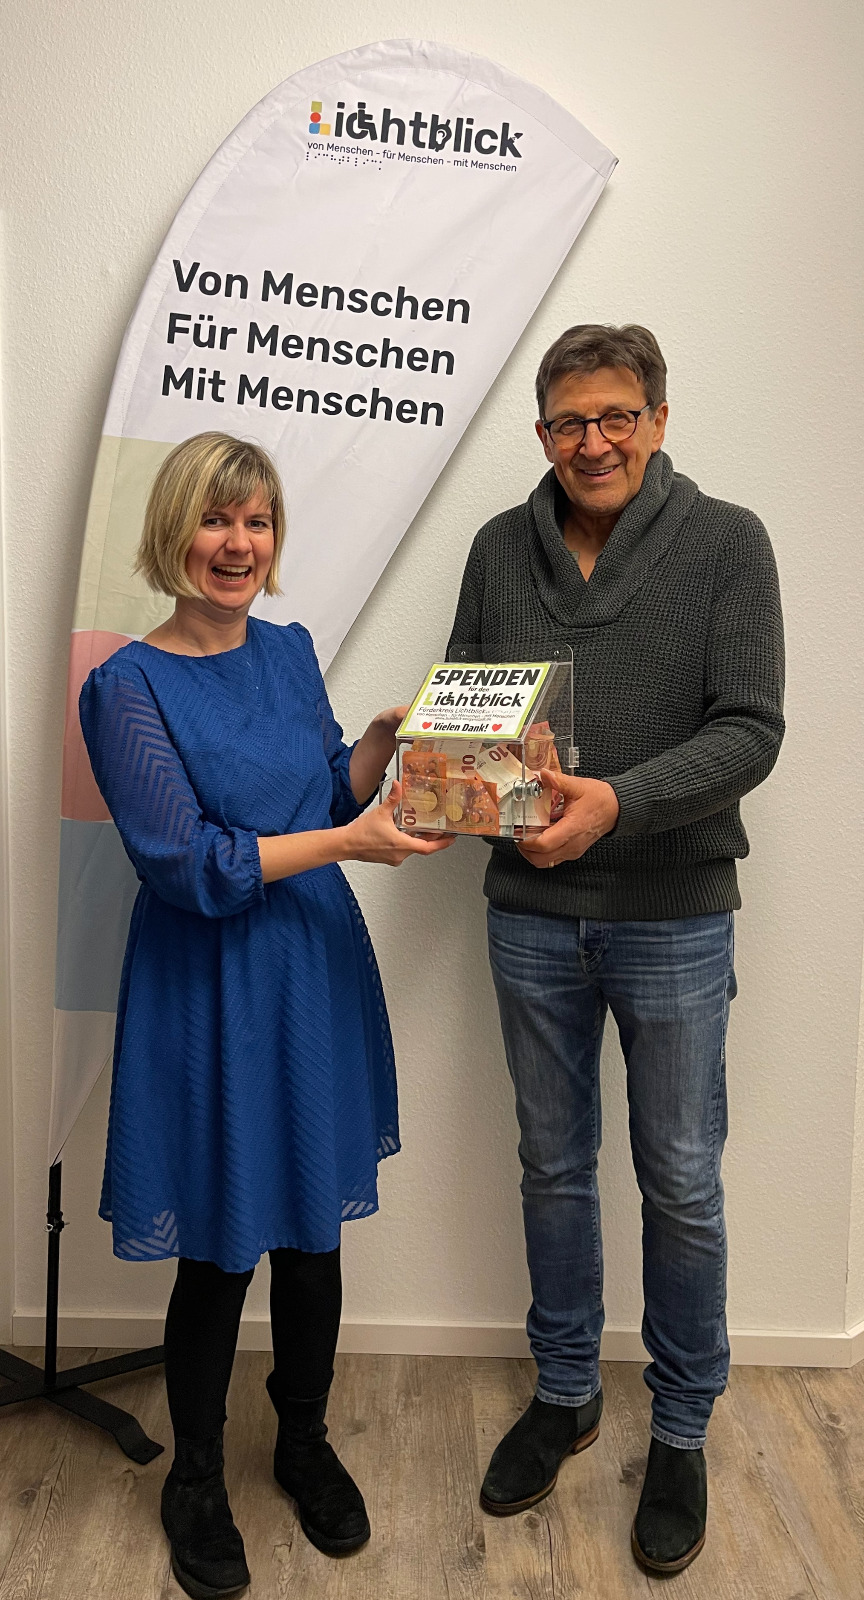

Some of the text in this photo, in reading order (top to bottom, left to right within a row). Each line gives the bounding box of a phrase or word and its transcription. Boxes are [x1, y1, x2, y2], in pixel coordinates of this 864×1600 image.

[307, 142, 325, 151] von
[326, 143, 374, 157] Menschen
[383, 149, 396, 159] für
[397, 152, 444, 165] Menschen
[453, 158, 468, 167] mit
[470, 160, 517, 172] Menschen
[172, 259, 471, 324] Von Menschen
[166, 312, 455, 376] Für Menschen
[161, 364, 445, 427] Mit Menschen
[431, 669, 541, 686] SPENDEN
[433, 722, 489, 733] Vielen Dank!
[461, 754, 476, 774] 10
[488, 746, 509, 762] 10
[403, 807, 417, 826] 10
